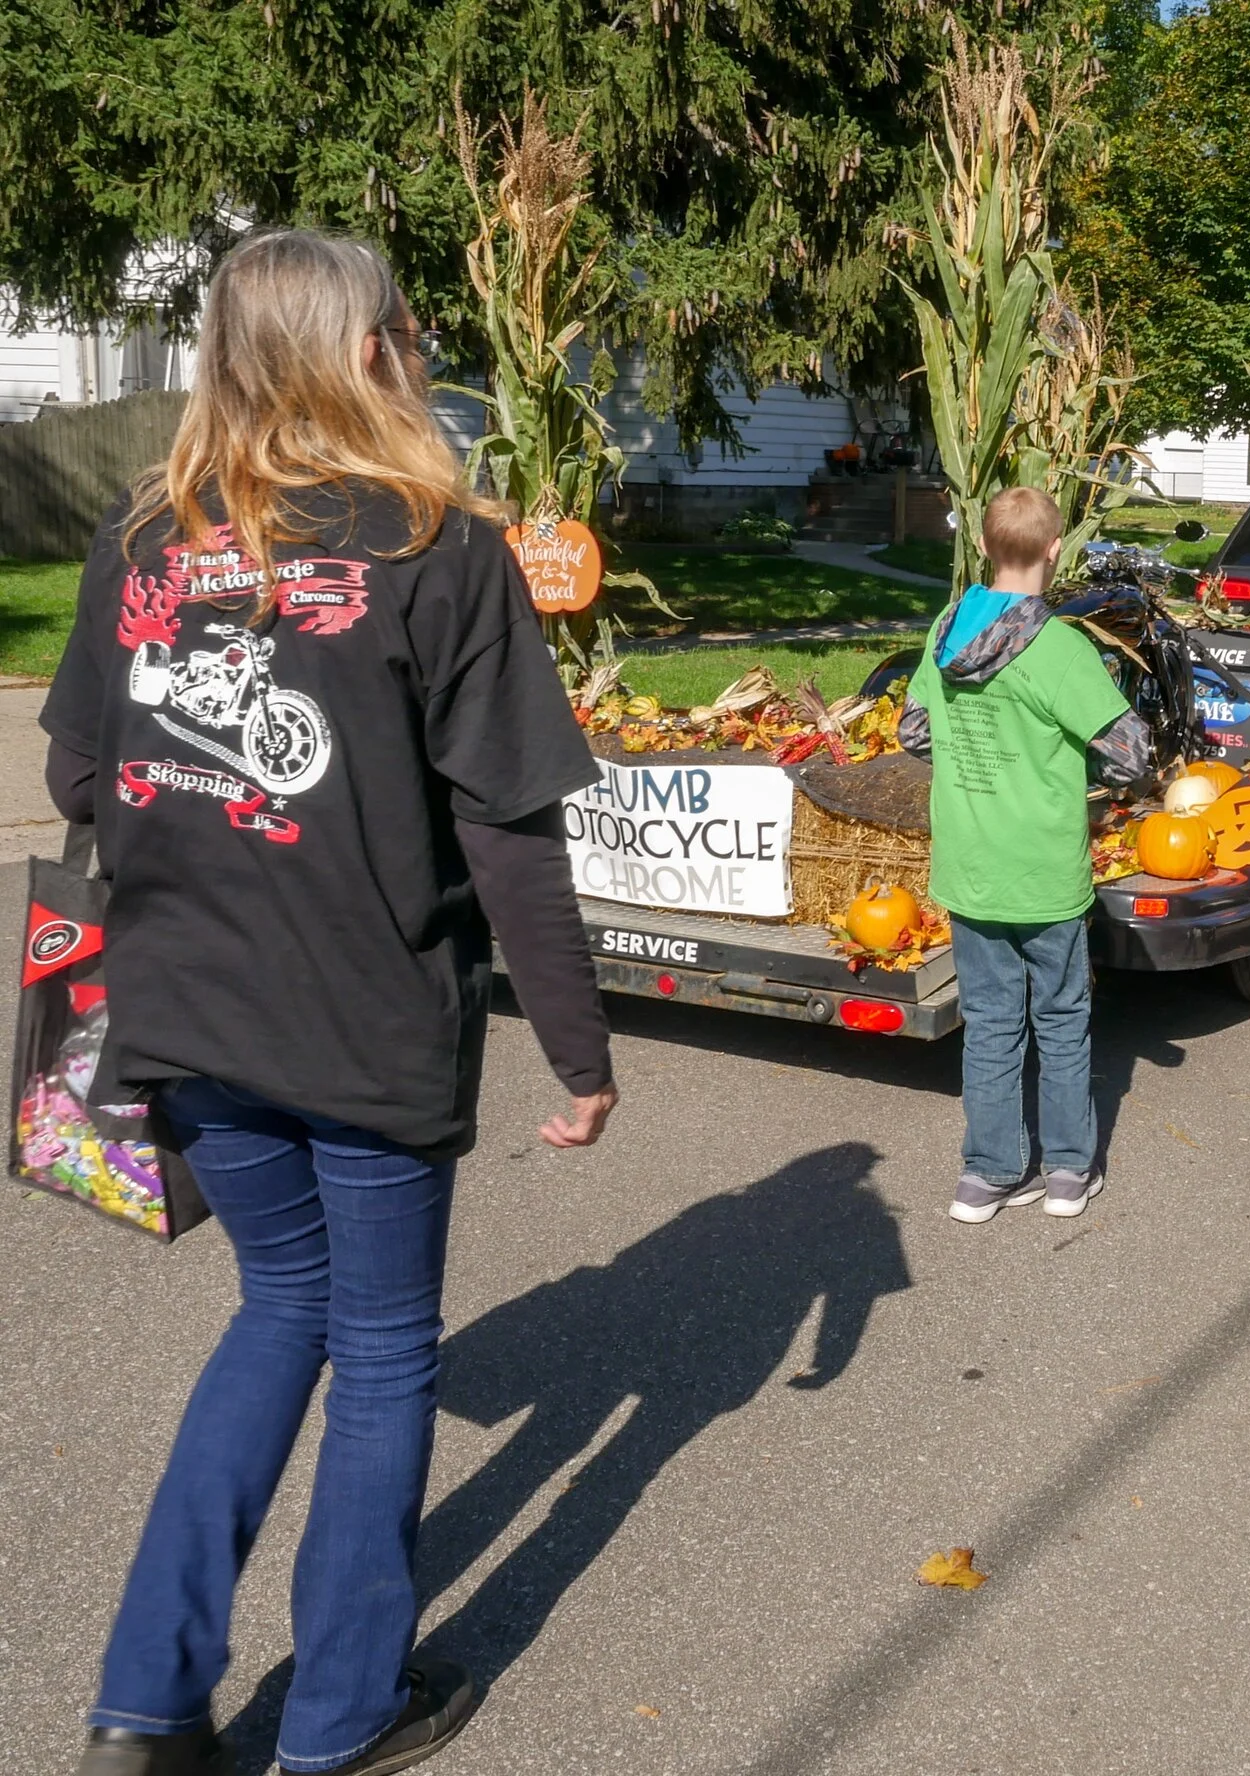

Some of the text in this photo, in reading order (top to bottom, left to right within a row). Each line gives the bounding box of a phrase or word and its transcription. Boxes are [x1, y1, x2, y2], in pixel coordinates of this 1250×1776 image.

[511, 536, 587, 570] Thankful
[290, 590, 345, 604] Chrome
[526, 576, 577, 600] lessed
[147, 762, 246, 803] Stopping
[585, 766, 712, 814] HUMB
[563, 801, 778, 862] OTORCYCLE
[582, 851, 746, 906] CHROME
[602, 929, 699, 963] SERVICE
